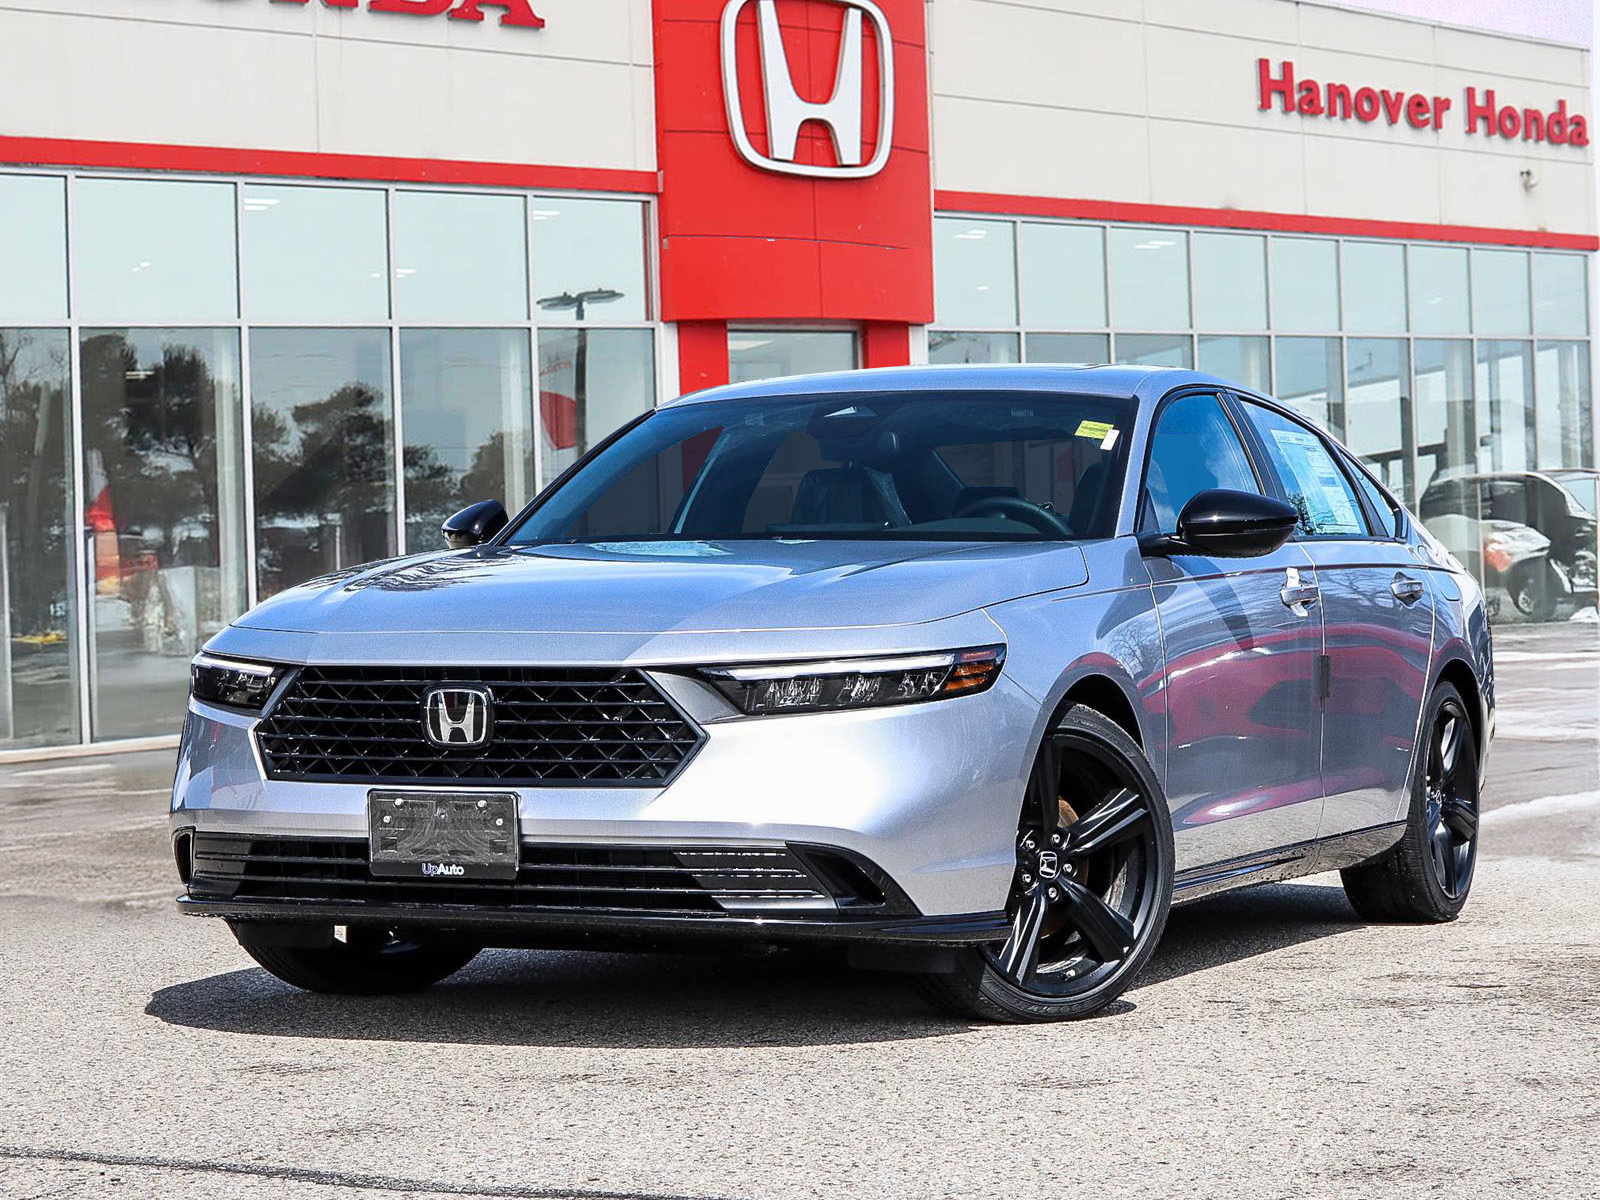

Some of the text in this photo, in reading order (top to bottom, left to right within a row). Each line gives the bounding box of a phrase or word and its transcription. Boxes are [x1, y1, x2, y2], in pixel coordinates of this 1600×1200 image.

[1257, 57, 1590, 147] Hanover Honda
[421, 862, 465, 876] UpAuto
